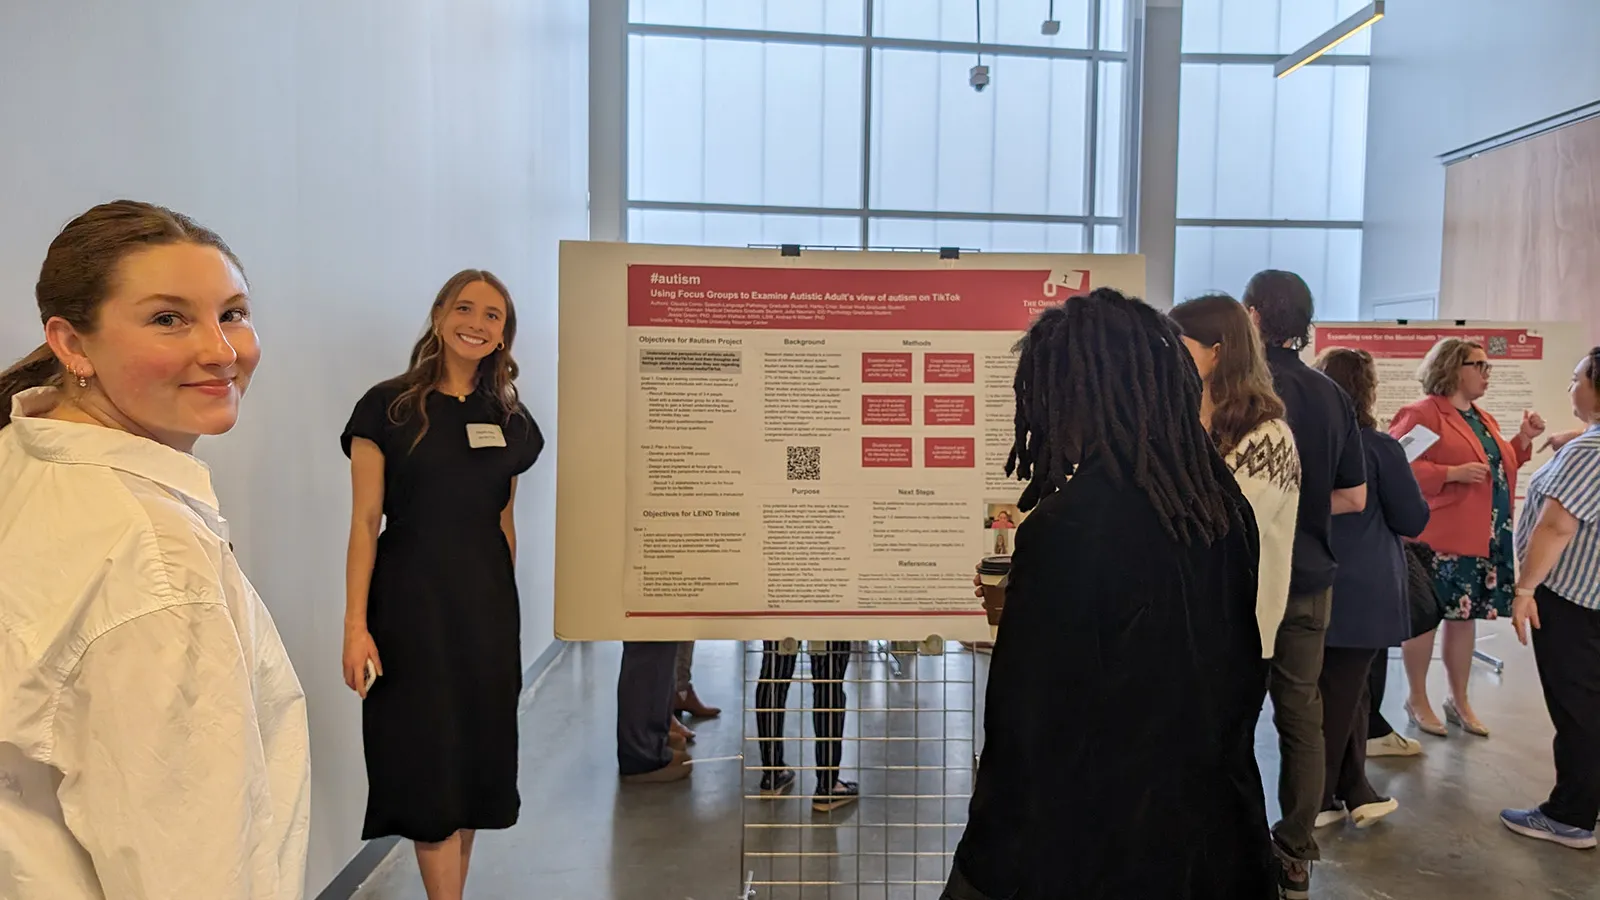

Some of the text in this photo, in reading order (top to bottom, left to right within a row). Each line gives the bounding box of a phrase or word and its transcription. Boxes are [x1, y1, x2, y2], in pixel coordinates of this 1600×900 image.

[650, 272, 700, 285] #autism
[650, 290, 676, 299] Using
[678, 290, 704, 298] Focus
[706, 290, 739, 300] Groups
[888, 293, 917, 301] autism
[932, 293, 961, 301] TikTok
